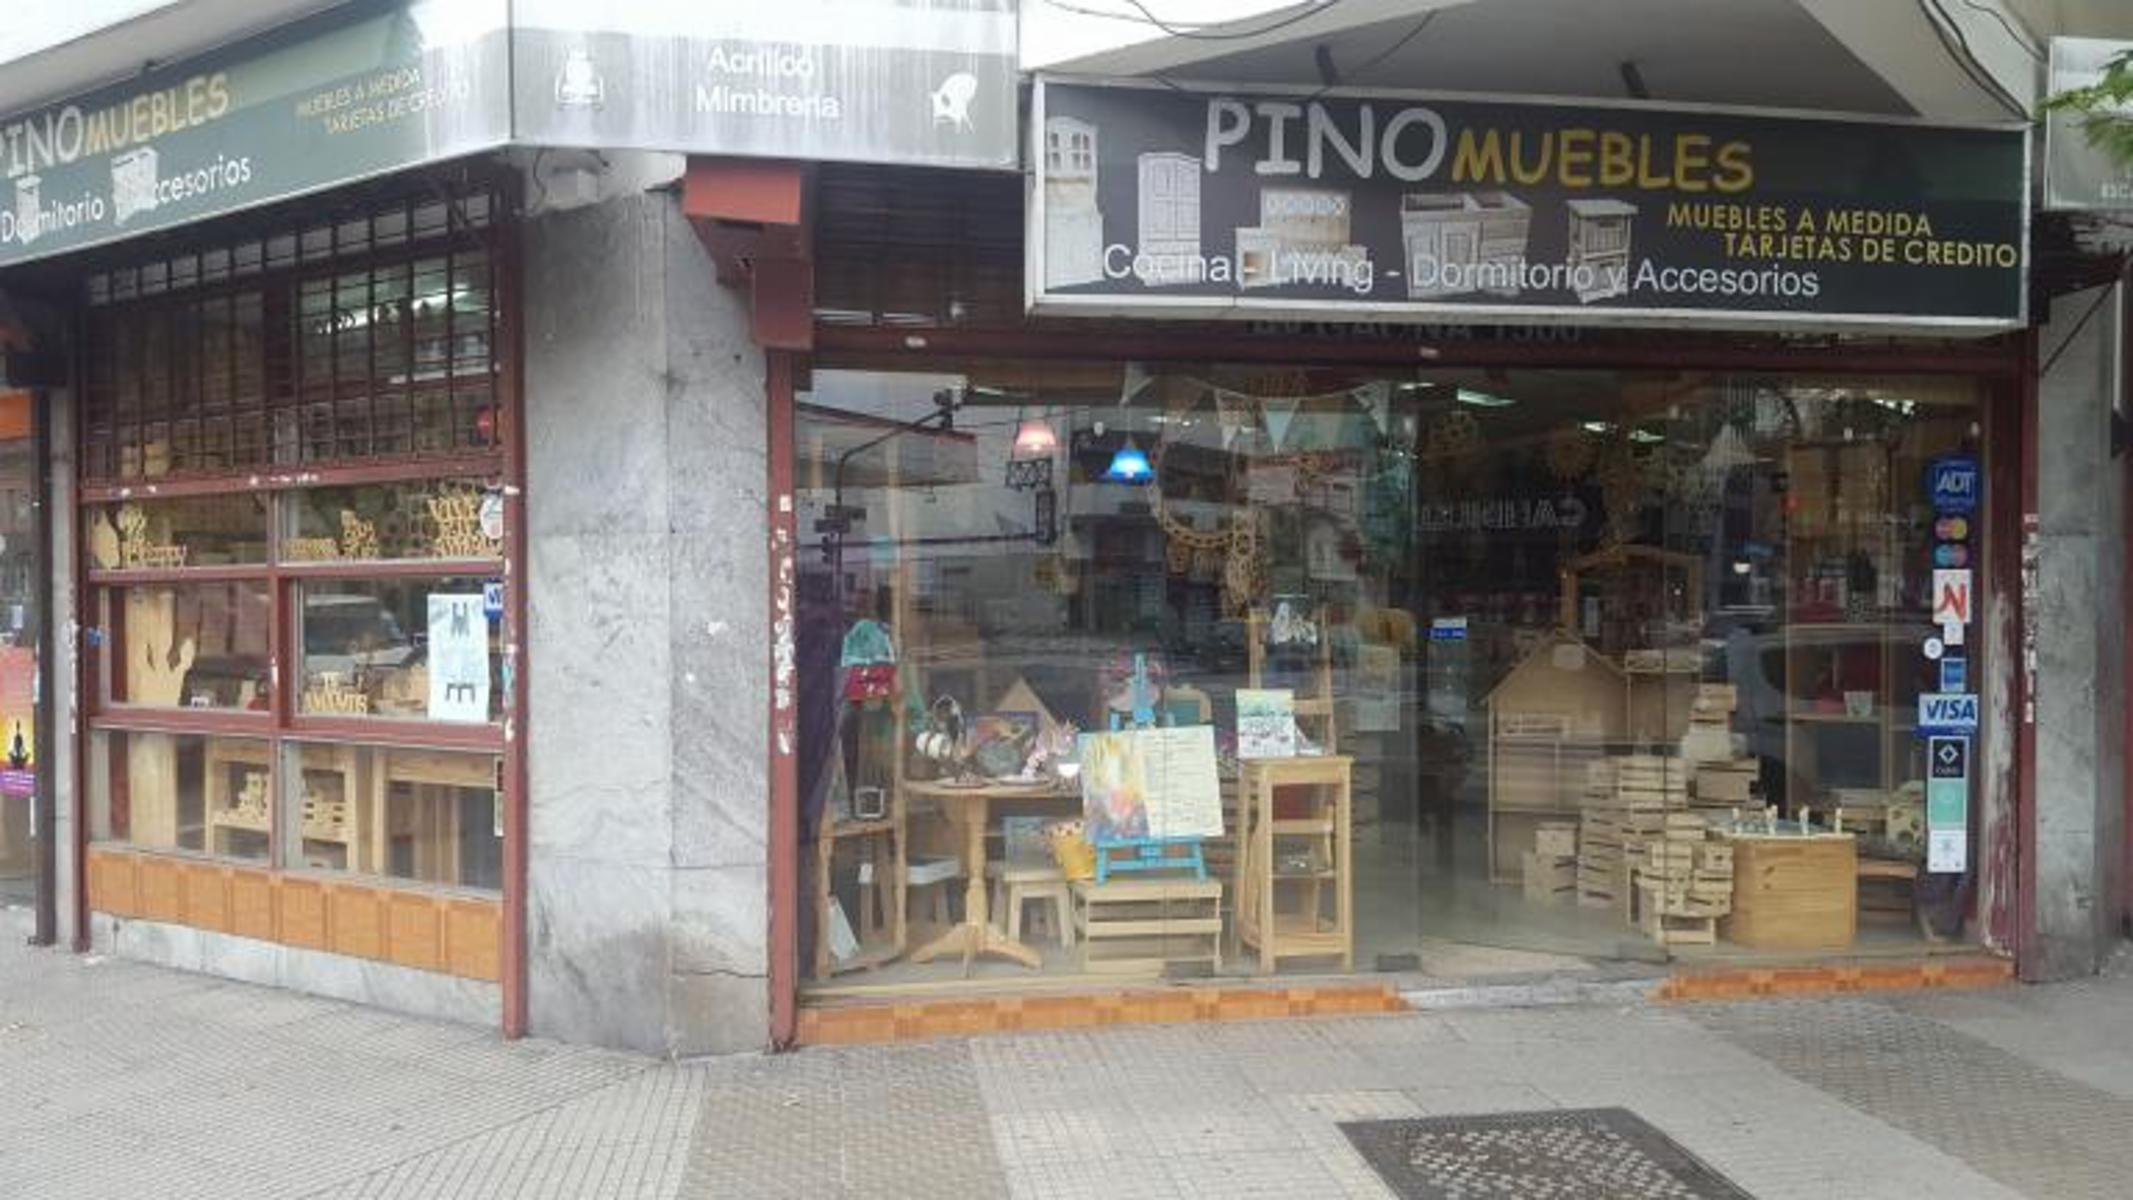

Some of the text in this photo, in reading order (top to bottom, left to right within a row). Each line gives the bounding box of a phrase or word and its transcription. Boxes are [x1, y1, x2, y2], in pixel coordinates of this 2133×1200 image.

[0, 72, 229, 179] INO MUEBLES
[1204, 97, 1755, 192] PINO MUEBLES
[1667, 203, 1933, 237] MUEBLES A MEDIDA
[1723, 232, 2018, 268] TARJETAS DE CREDITO
[1103, 243, 1231, 283] Cocina
[1270, 246, 1375, 294] Living
[1411, 252, 1594, 290] Dormitorio
[1632, 257, 1821, 297] Accesorios
[1936, 471, 1977, 495] ADT
[1926, 699, 1976, 721] VISA
